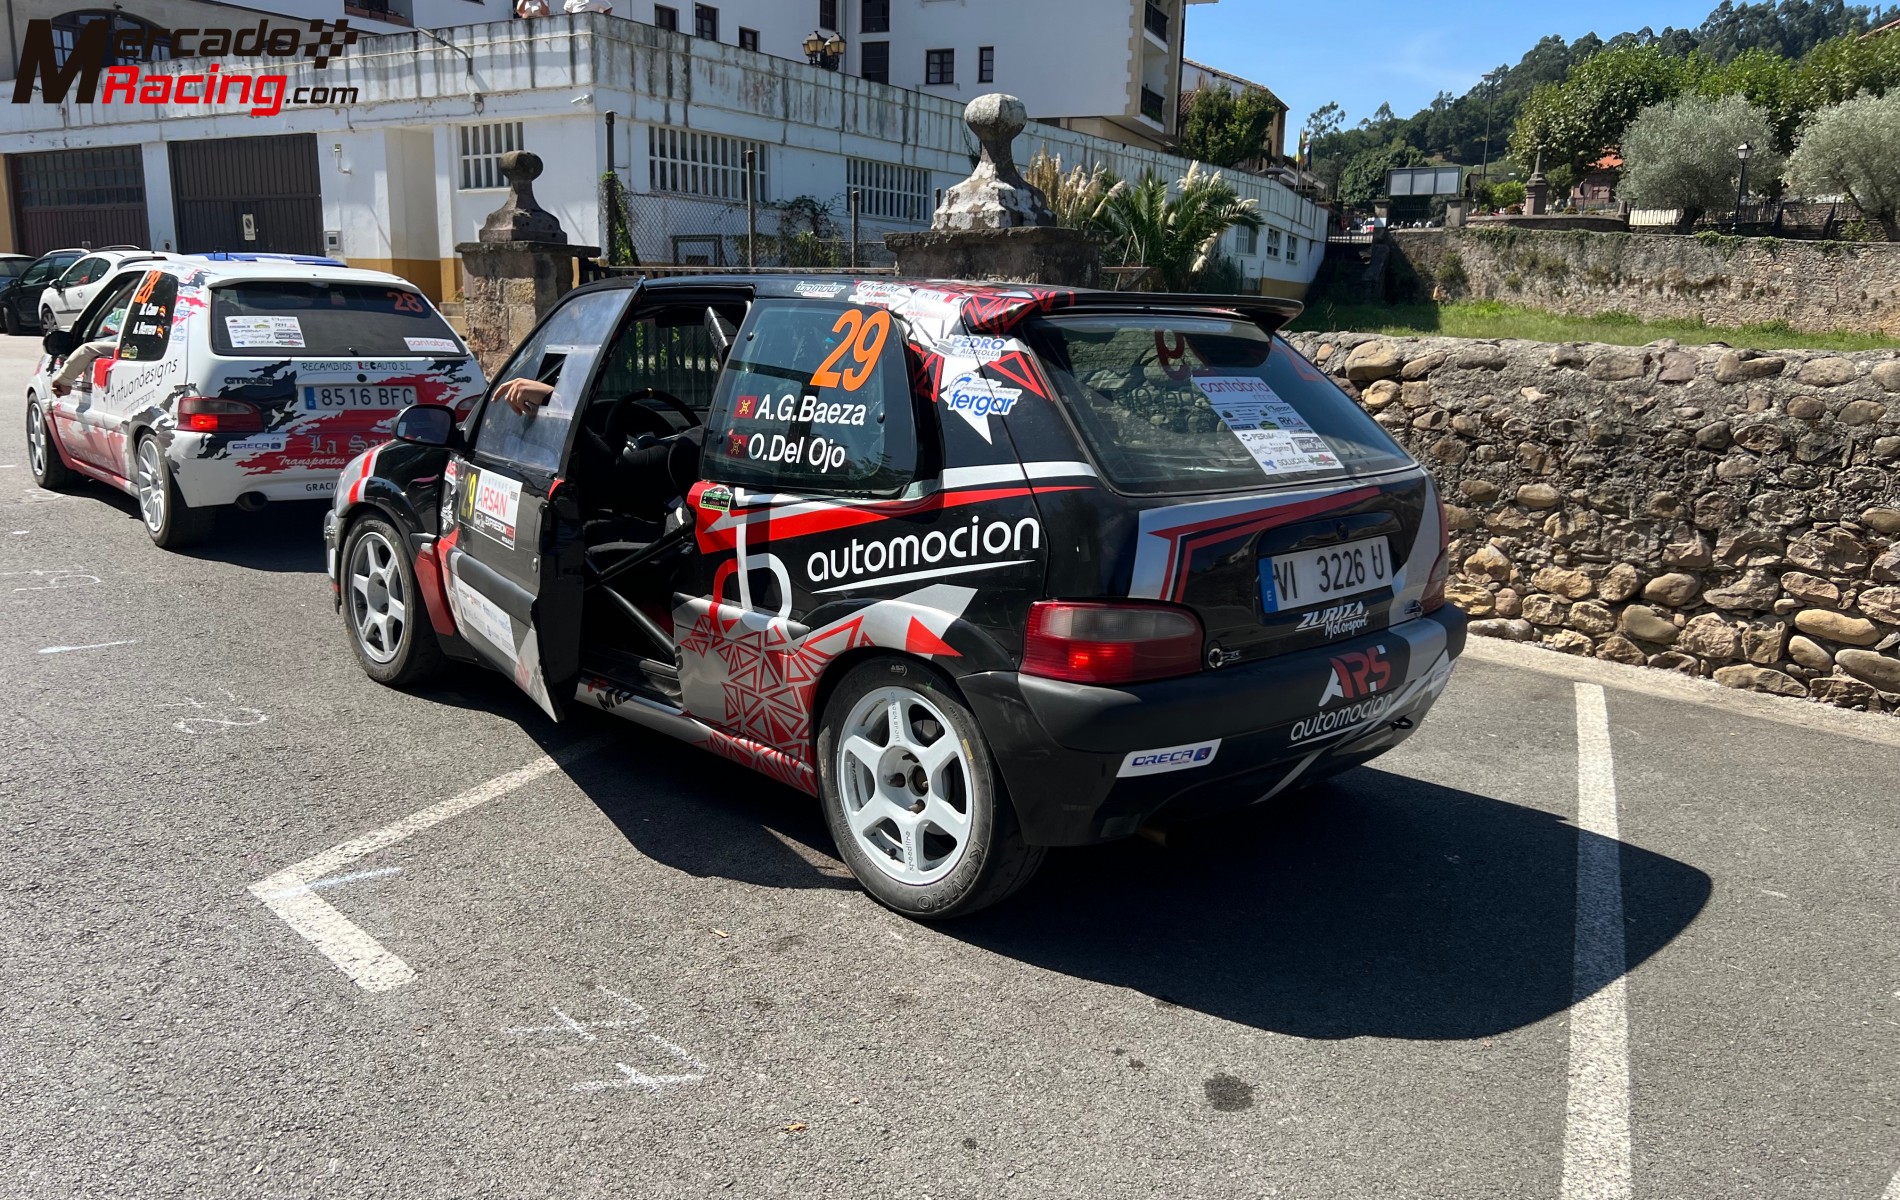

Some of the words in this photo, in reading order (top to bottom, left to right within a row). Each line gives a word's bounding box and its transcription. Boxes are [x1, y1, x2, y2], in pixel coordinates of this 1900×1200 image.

[134, 269, 162, 304] 28
[386, 291, 424, 312] 28
[809, 309, 890, 392] 29
[952, 337, 1005, 350] PEDRO
[301, 362, 353, 372] RECAMBIOS
[357, 361, 398, 371] RECAUTO
[321, 388, 371, 406] 8516
[379, 388, 414, 405] BFC
[1200, 378, 1270, 393] cantabria
[754, 394, 867, 426] A.G.Baeza
[950, 389, 1015, 416] fergar
[310, 435, 337, 454] La
[748, 433, 805, 463] O.Del
[808, 437, 846, 473] Ojo
[276, 455, 345, 467] Transportes
[461, 472, 477, 520] 29
[476, 485, 508, 518] ARSAN
[807, 515, 1040, 582] automocion
[1273, 560, 1298, 601] VI
[1316, 548, 1366, 593] 3226
[1371, 544, 1385, 580] U
[1266, 590, 1271, 602] E
[1296, 601, 1364, 630] ZURITA
[1324, 609, 1370, 639] Motorsport
[1318, 644, 1391, 707] ARS
[1290, 693, 1394, 741] automocion
[916, 840, 986, 912] KUMHO
